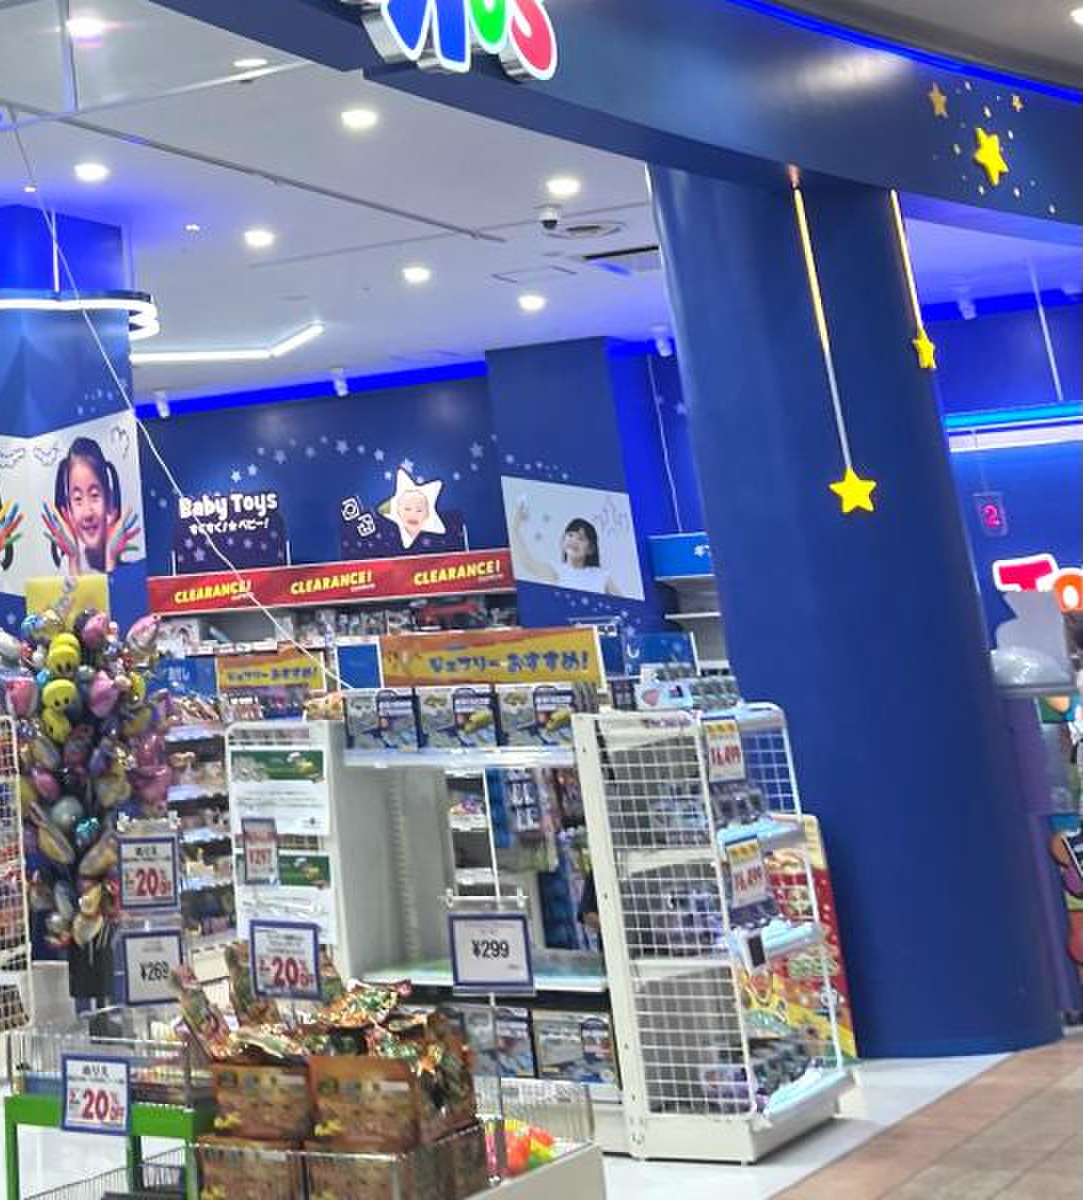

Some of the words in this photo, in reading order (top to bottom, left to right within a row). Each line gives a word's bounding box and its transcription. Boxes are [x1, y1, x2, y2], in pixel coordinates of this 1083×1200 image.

[179, 495, 228, 521] Baby
[230, 493, 278, 517] Toys
[983, 504, 1000, 528] 2
[290, 570, 372, 595] CLEARANCE!
[411, 560, 501, 586] CLEARANCE!
[174, 579, 252, 604] CLEARANCE!
[135, 867, 159, 897] 20
[472, 939, 509, 959] ¥299
[271, 957, 299, 990] 20
[82, 1088, 109, 1121] 20
